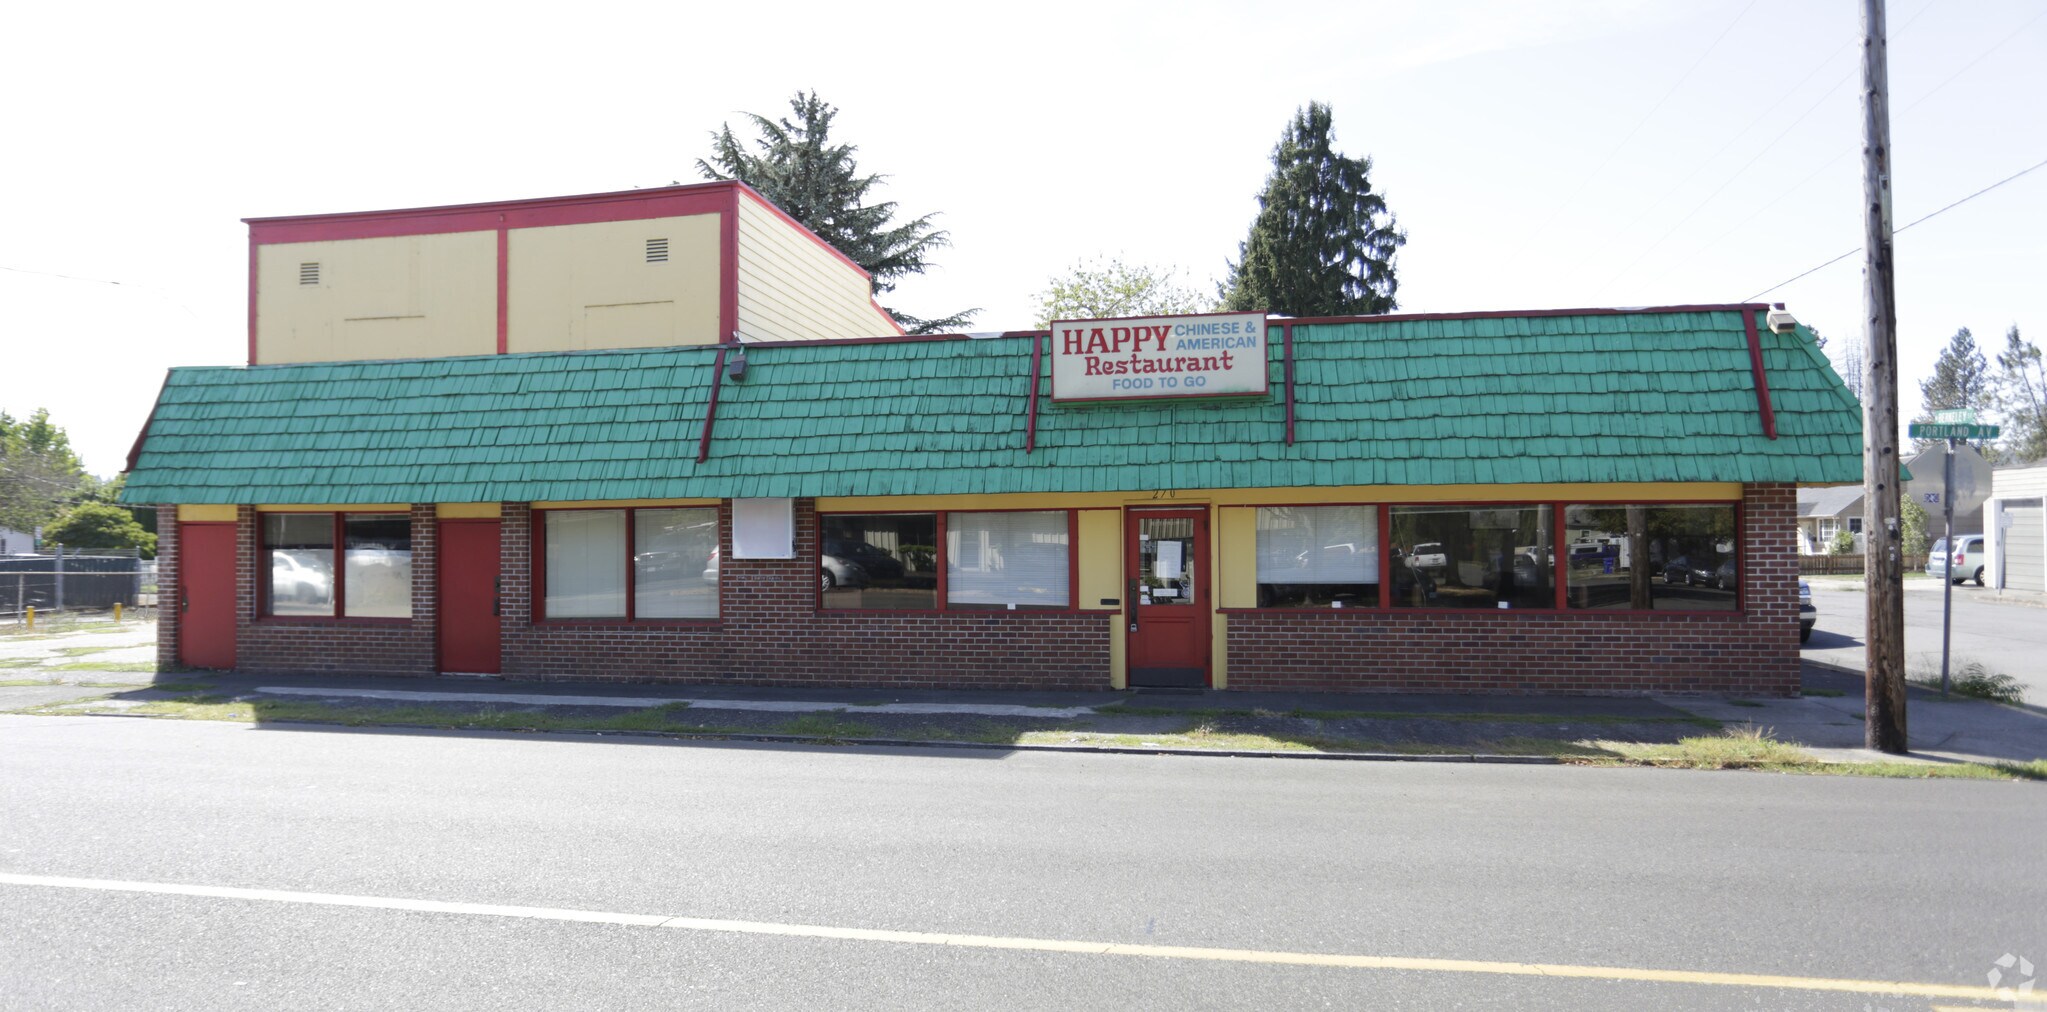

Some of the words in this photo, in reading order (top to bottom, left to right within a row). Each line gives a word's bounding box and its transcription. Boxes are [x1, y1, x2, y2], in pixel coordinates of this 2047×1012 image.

[1175, 322, 1239, 336] CHINESE
[1245, 321, 1256, 334] &
[1062, 325, 1172, 355] HAPPY
[1176, 336, 1256, 350] AMERICAN
[1084, 350, 1233, 376] Restaurant
[1112, 378, 1153, 390] FOOD
[1158, 377, 1178, 388] TO
[1184, 376, 1206, 387] GO
[1919, 425, 1969, 437] PORTLAND
[1978, 426, 1992, 436] AV
